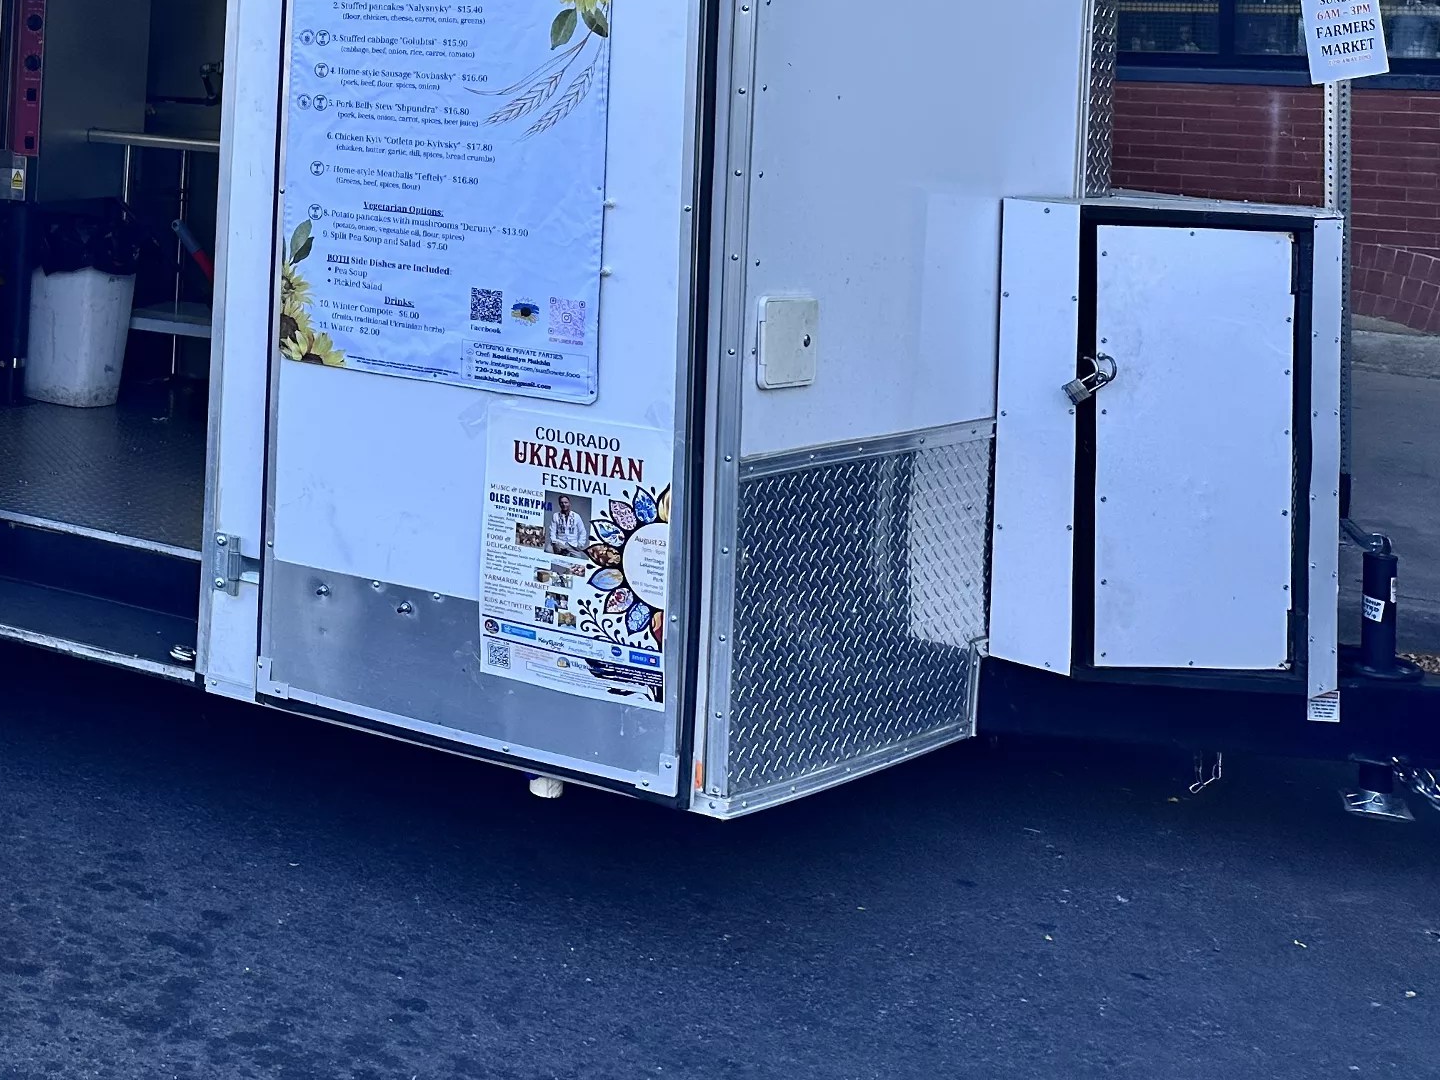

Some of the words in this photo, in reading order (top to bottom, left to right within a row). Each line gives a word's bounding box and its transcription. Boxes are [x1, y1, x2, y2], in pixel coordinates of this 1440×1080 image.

[340, 1, 368, 9] Stuffed
[368, 2, 404, 13] pancakes
[457, 4, 483, 13] $15.40
[1316, 8, 1340, 21] 6AM
[1351, 3, 1371, 16] 3PM
[1316, 18, 1376, 39] FARMERS
[339, 34, 366, 42] Stuffed
[366, 35, 398, 46] cabbage
[442, 38, 468, 47] $15.90
[1321, 37, 1375, 57] MARKET
[380, 68, 412, 80] Sausage
[335, 99, 354, 108] Pork
[355, 100, 373, 111] Belly
[374, 101, 392, 110] Stew
[443, 105, 470, 116] $16.80
[334, 132, 364, 141] Chicken
[365, 134, 381, 145] Kyiv
[466, 141, 493, 151] $17.80
[452, 174, 479, 185] $16.80
[362, 202, 408, 216] Vegetarian
[355, 211, 391, 225] pancakes
[392, 215, 410, 224] with
[411, 217, 458, 229] mushrooms
[501, 226, 529, 237] $13.90
[378, 225, 410, 237] vegetable
[348, 232, 362, 241] Pea
[362, 234, 382, 245] Soup
[383, 236, 398, 245] and
[399, 237, 421, 247] Salad
[326, 253, 349, 265] BOTH
[350, 256, 367, 266] Side
[369, 258, 396, 269] Dishes
[334, 265, 347, 274] Pea
[348, 267, 367, 278] Soup
[333, 277, 360, 288] Pickled
[361, 280, 382, 290] Salad
[331, 300, 358, 311] Winter
[359, 303, 393, 318] Compote
[330, 322, 353, 332] Water
[359, 325, 380, 336] $2.00
[512, 347, 537, 356] PRIVATE
[535, 426, 620, 452] COLORADO
[513, 439, 644, 483] UKRAINIAN
[490, 483, 511, 492] MUSIC
[518, 487, 544, 497] DANCES
[542, 472, 611, 497] FESTIVAL
[489, 491, 510, 505] OLEG
[512, 495, 553, 512] SKRYPKA
[486, 532, 504, 541] FOOD
[634, 535, 657, 546] August
[484, 573, 519, 586] YARMAROK
[524, 580, 549, 591] MARKET
